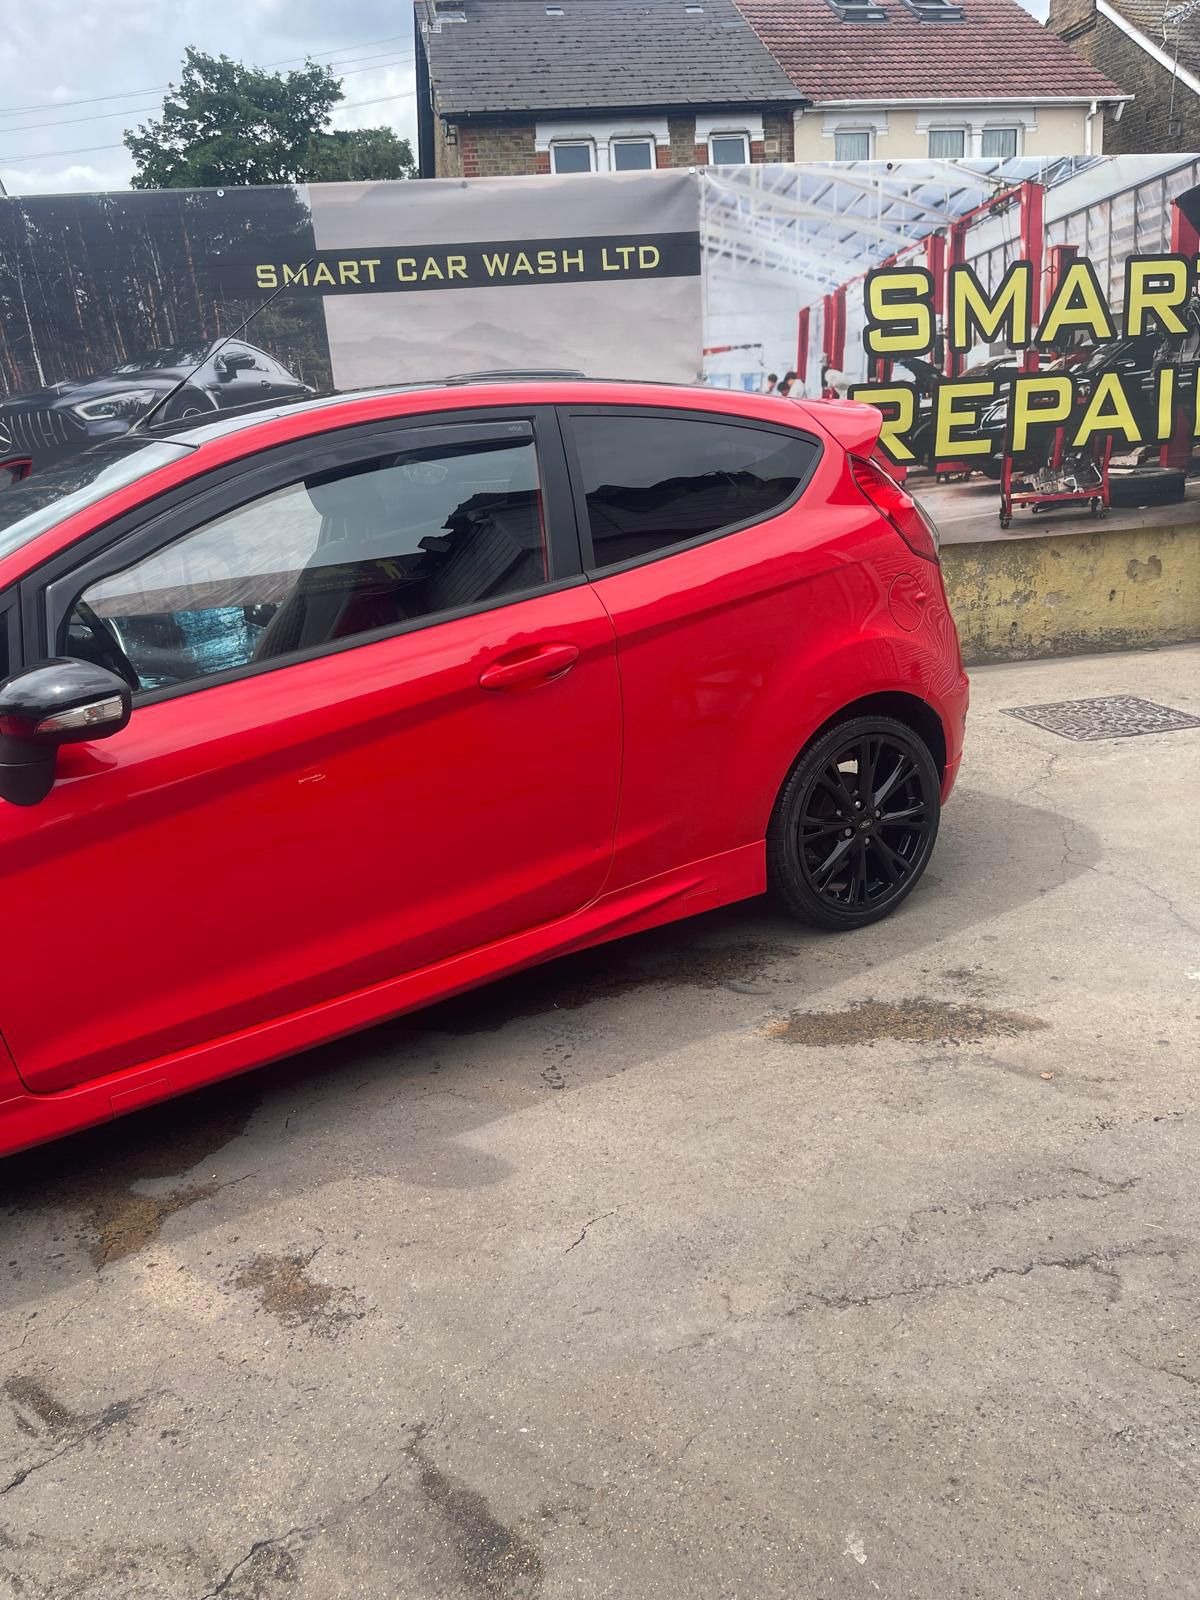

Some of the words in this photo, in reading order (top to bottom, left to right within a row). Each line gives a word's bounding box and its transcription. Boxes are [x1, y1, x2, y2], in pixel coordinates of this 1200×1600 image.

[255, 258, 382, 289] SMART
[396, 255, 470, 282] CAR
[481, 248, 585, 277] WASH
[601, 245, 661, 272] LTD
[868, 259, 1200, 352] SMAR
[853, 366, 1200, 460] REPAI
